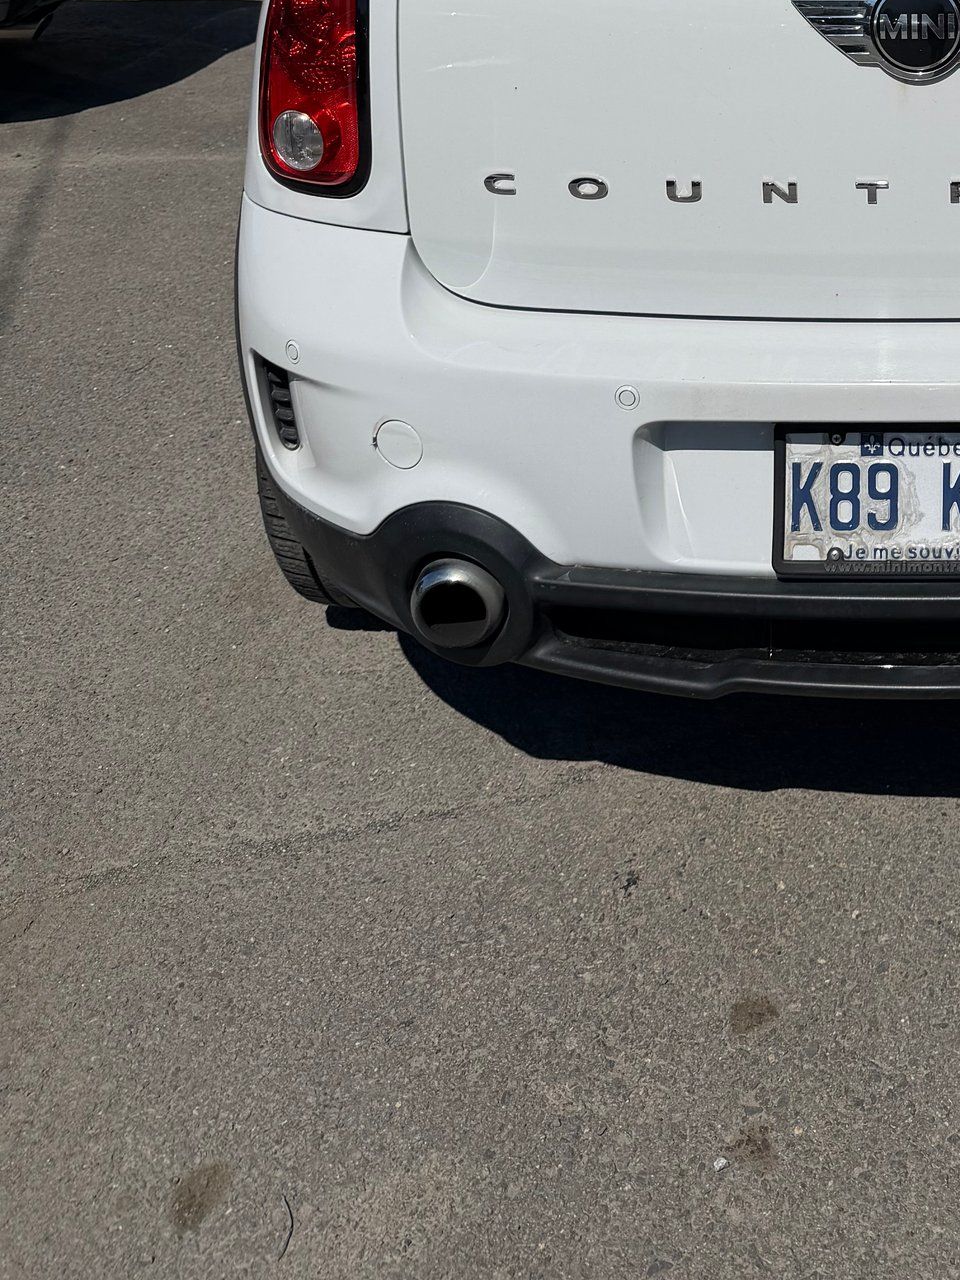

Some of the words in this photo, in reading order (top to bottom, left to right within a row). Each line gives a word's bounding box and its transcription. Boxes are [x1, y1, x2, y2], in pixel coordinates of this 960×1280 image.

[879, 13, 956, 40] MINI
[790, 461, 899, 532] K89
[843, 545, 866, 560] Je
[873, 546, 901, 560] me
